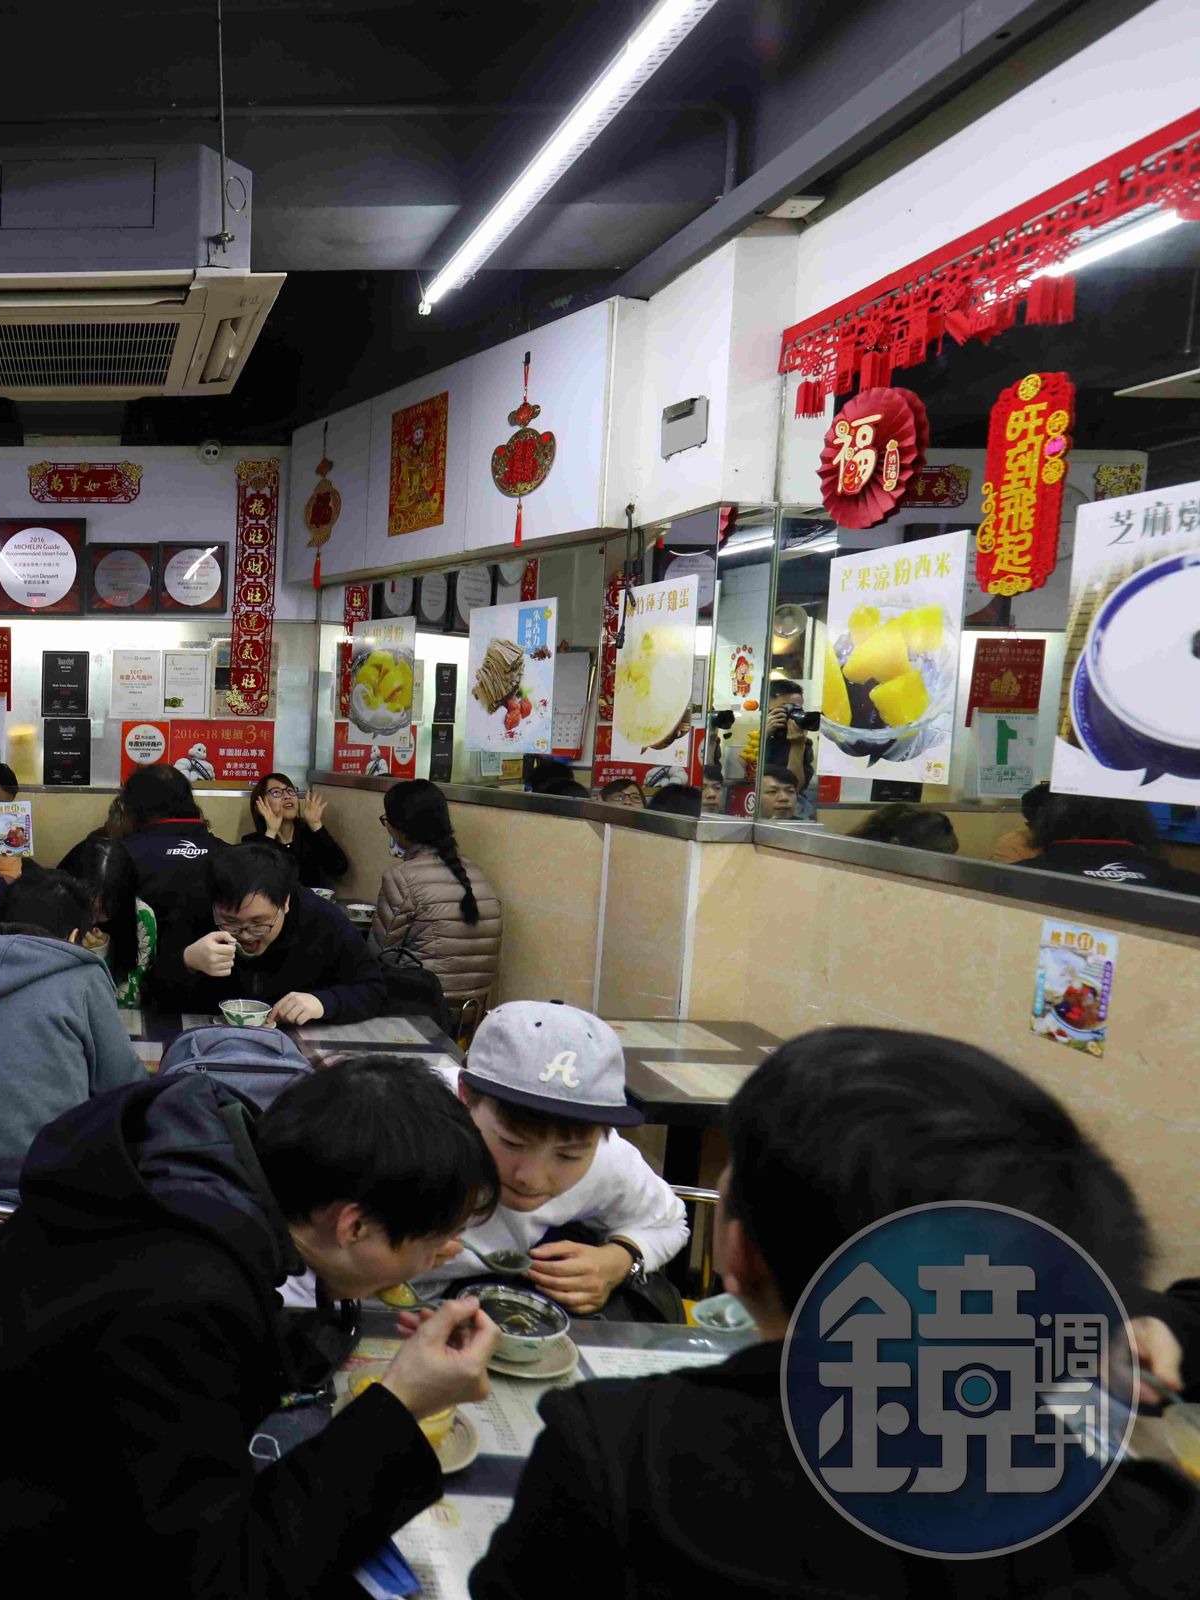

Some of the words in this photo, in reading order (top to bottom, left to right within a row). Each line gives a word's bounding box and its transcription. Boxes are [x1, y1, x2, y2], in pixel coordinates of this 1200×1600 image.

[833, 414, 882, 493] 福
[841, 552, 952, 592] 芒果涼粉西米
[174, 729, 218, 740] 2016-18
[538, 1050, 580, 1088] A
